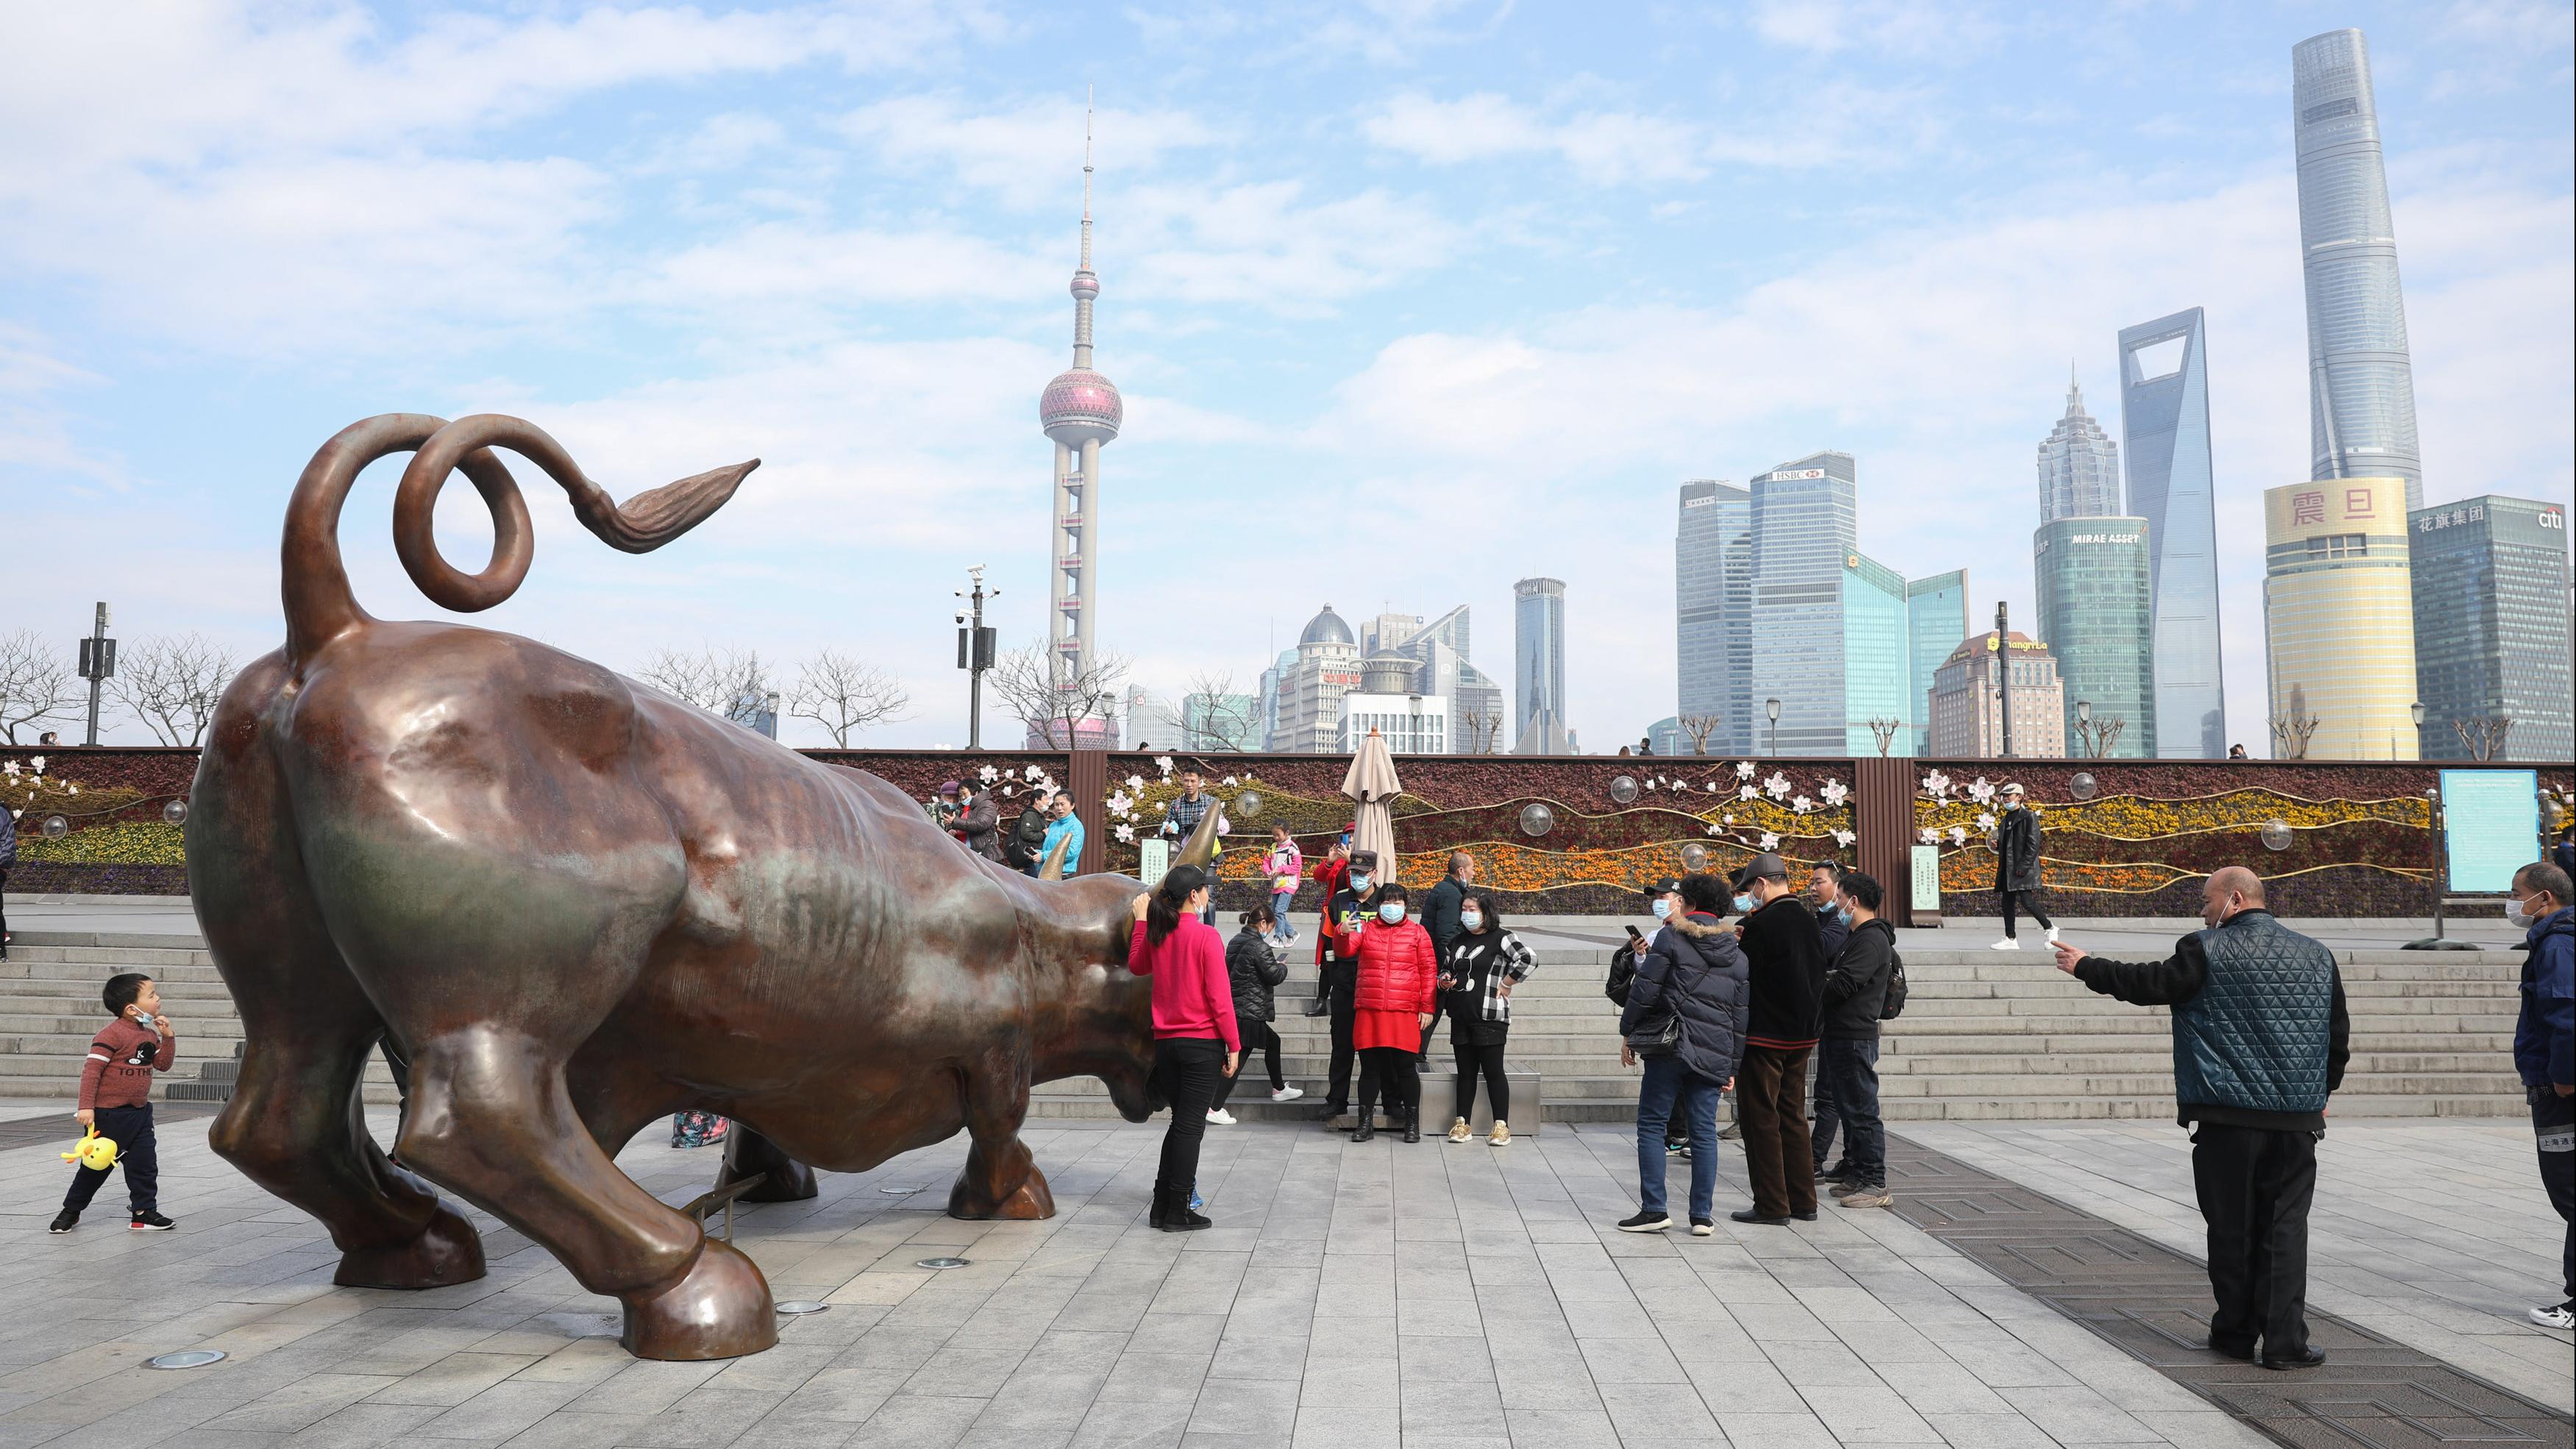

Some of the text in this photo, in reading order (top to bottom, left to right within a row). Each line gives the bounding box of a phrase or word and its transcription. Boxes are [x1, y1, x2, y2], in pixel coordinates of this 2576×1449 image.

[1776, 471, 1804, 480] HSBC
[2293, 488, 2375, 527] 震旦
[2419, 505, 2484, 533] 花旗集团
[2538, 510, 2562, 530] citi
[2072, 534, 2139, 544] MIRAE ASSET
